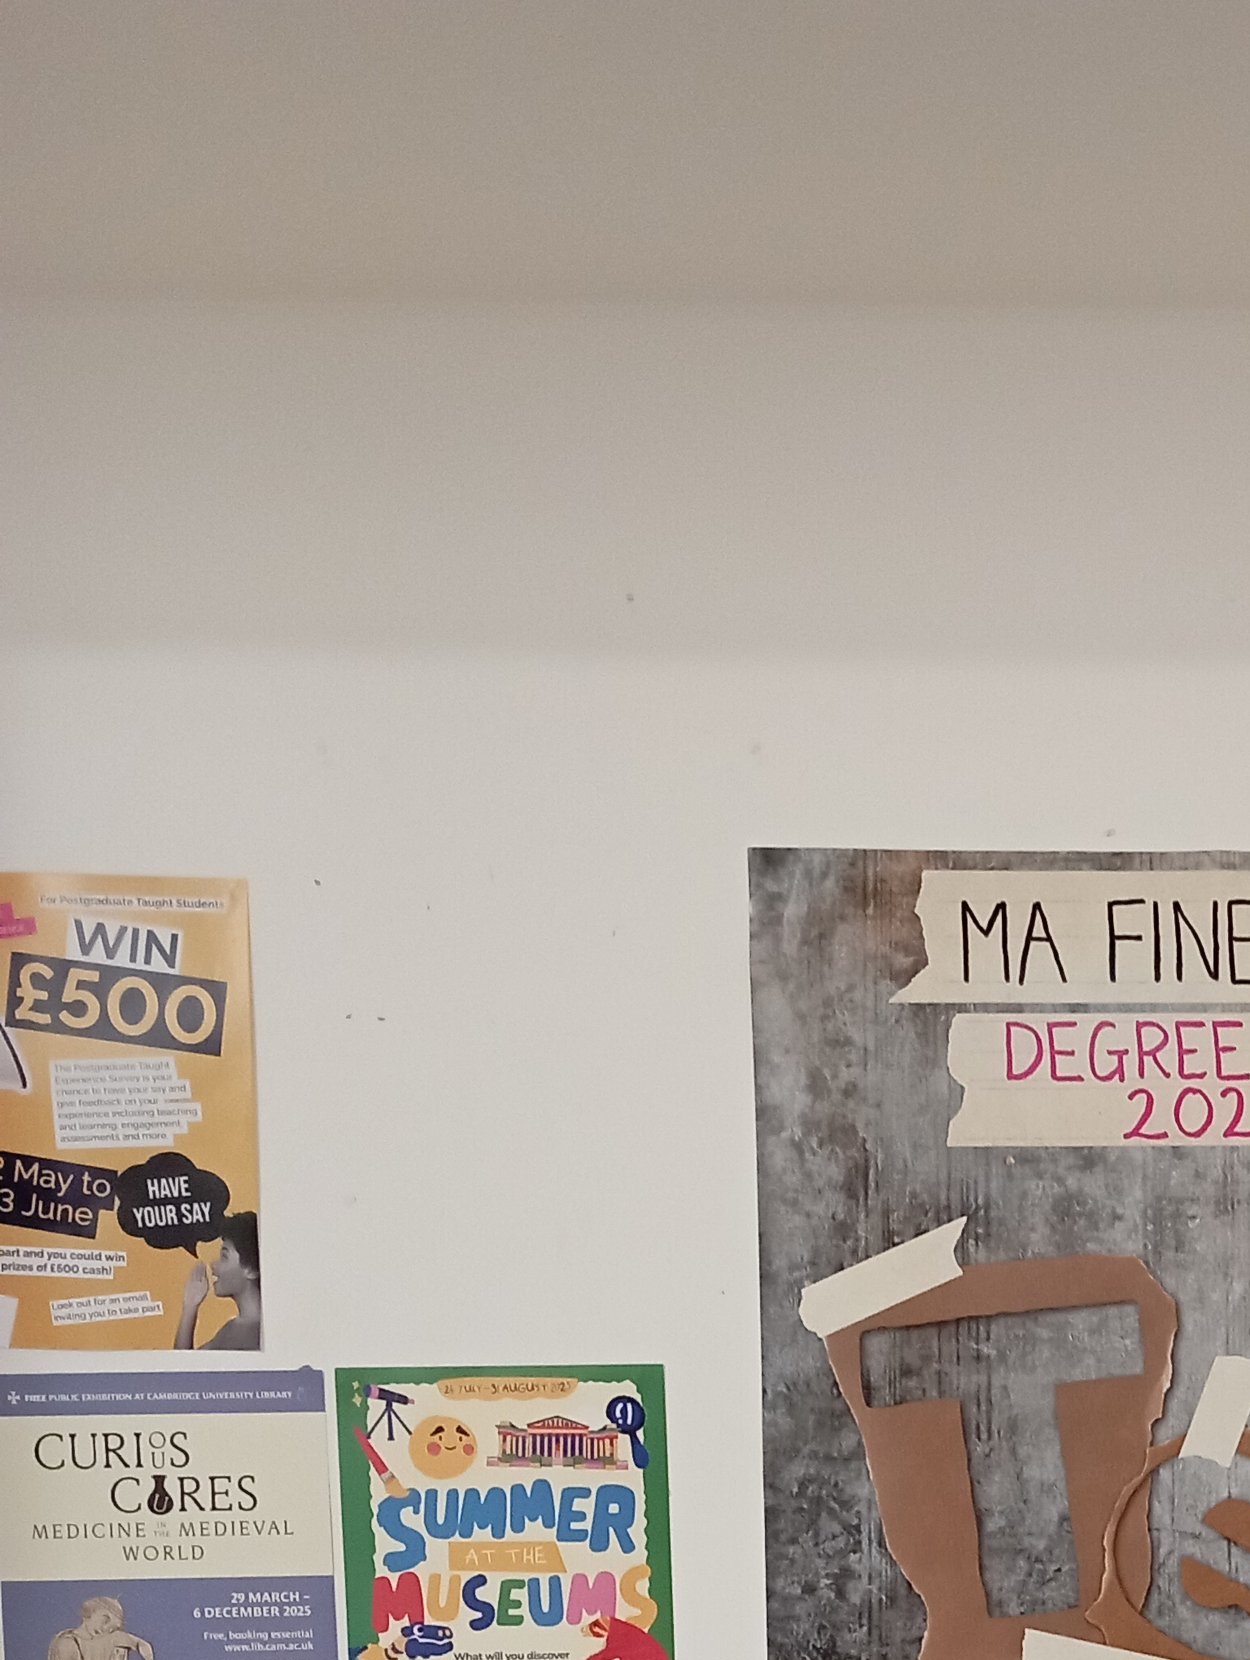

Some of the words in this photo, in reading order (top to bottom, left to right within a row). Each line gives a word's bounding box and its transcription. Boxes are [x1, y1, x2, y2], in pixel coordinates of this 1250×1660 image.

[74, 918, 178, 969] WIN
[961, 901, 1067, 985] MA
[14, 962, 217, 1044] £500
[14, 1159, 74, 1196] May
[82, 1172, 111, 1197] to
[147, 1175, 191, 1199] HAVE
[22, 1193, 93, 1226] June
[133, 1205, 178, 1228] YOUR
[182, 1202, 211, 1224] SAY
[23, 1249, 43, 1259] and
[46, 1251, 68, 1262] you
[70, 1251, 102, 1262] could
[105, 1253, 125, 1262] win
[1, 1262, 34, 1275] prizes
[50, 1263, 79, 1274] £500
[82, 1265, 112, 1276] cash!
[111, 1475, 258, 1515] CURES
[32, 1522, 146, 1540] MEDICINE
[179, 1520, 294, 1537] MEDIEVAL
[376, 1478, 636, 1572] SUMMER
[122, 1545, 205, 1561] WORLD
[465, 1550, 495, 1564] AT
[506, 1547, 546, 1563] THE
[231, 1593, 245, 1603] 29
[248, 1592, 299, 1602] MARCH
[371, 1563, 658, 1633] MUSEUMS
[193, 1608, 200, 1618] 6
[204, 1606, 280, 1618] DECEMBER
[283, 1605, 311, 1616] 2025
[229, 1631, 268, 1641] booking
[271, 1629, 313, 1639] essential
[454, 1652, 482, 1660] What
[487, 1652, 503, 1660] will
[527, 1651, 569, 1660] discover
